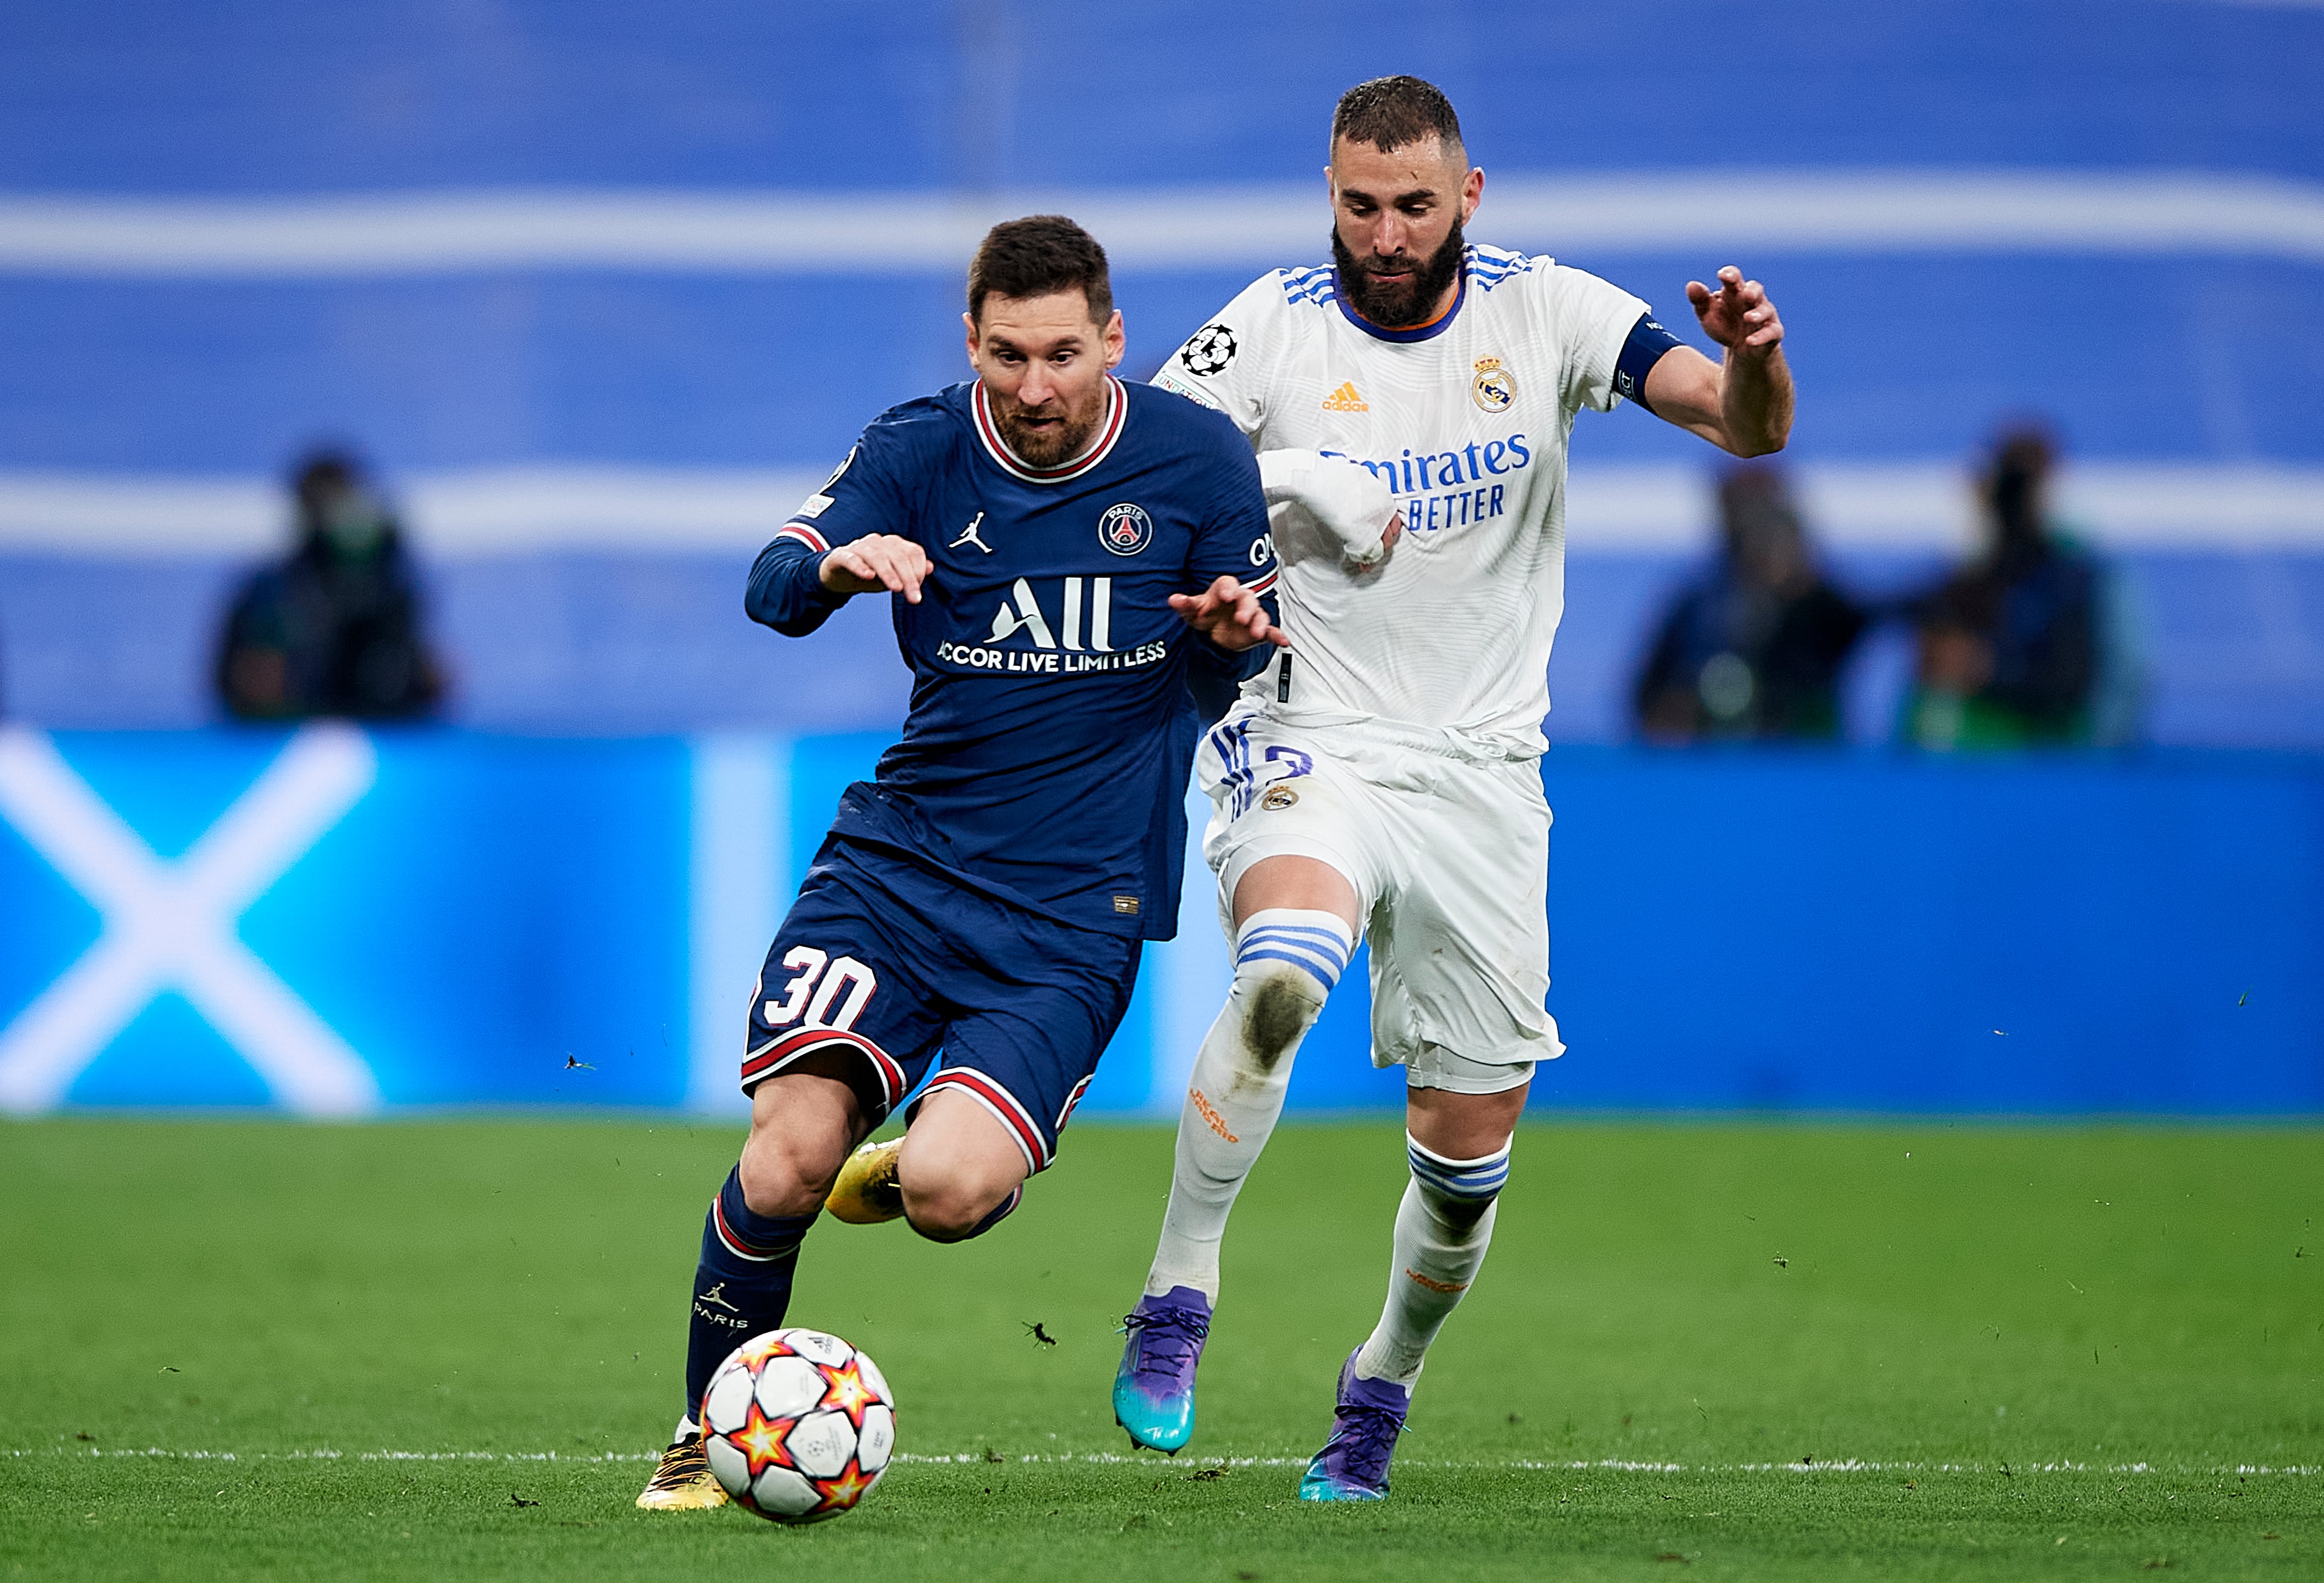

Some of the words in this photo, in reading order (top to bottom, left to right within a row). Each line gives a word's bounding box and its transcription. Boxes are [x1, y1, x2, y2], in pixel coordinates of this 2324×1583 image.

[1322, 400, 1368, 412] adidas
[1108, 506, 1143, 520] PARIS
[1408, 484, 1504, 531] BETTER
[1008, 652, 1059, 672] LIVE
[1065, 640, 1166, 672] LIMITLESS
[763, 945, 878, 1032] 30
[691, 1301, 748, 1329] PARIS
